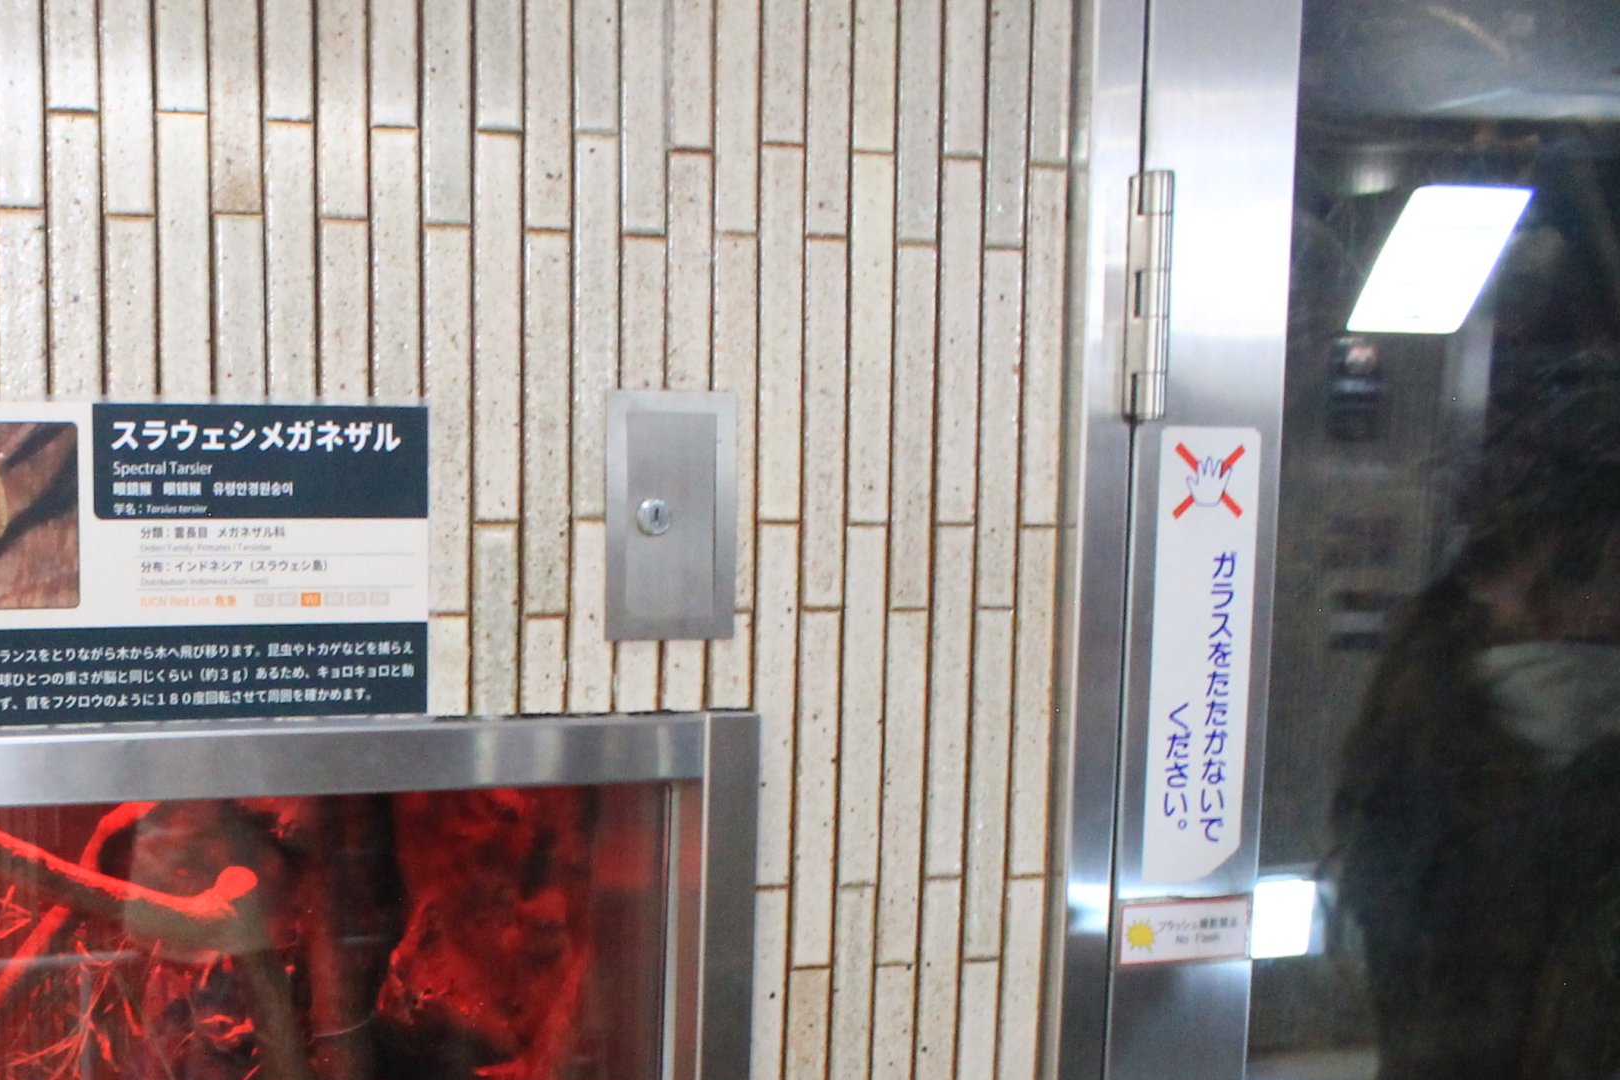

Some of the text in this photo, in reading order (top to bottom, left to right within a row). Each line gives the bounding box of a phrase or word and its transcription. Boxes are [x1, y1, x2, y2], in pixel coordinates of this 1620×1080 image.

[111, 419, 401, 454] スラウェシメガネザル
[112, 460, 213, 477] Spectral Tarsier
[1199, 551, 1238, 843] ガラスをたたかないで
[1164, 702, 1189, 830] ください。
